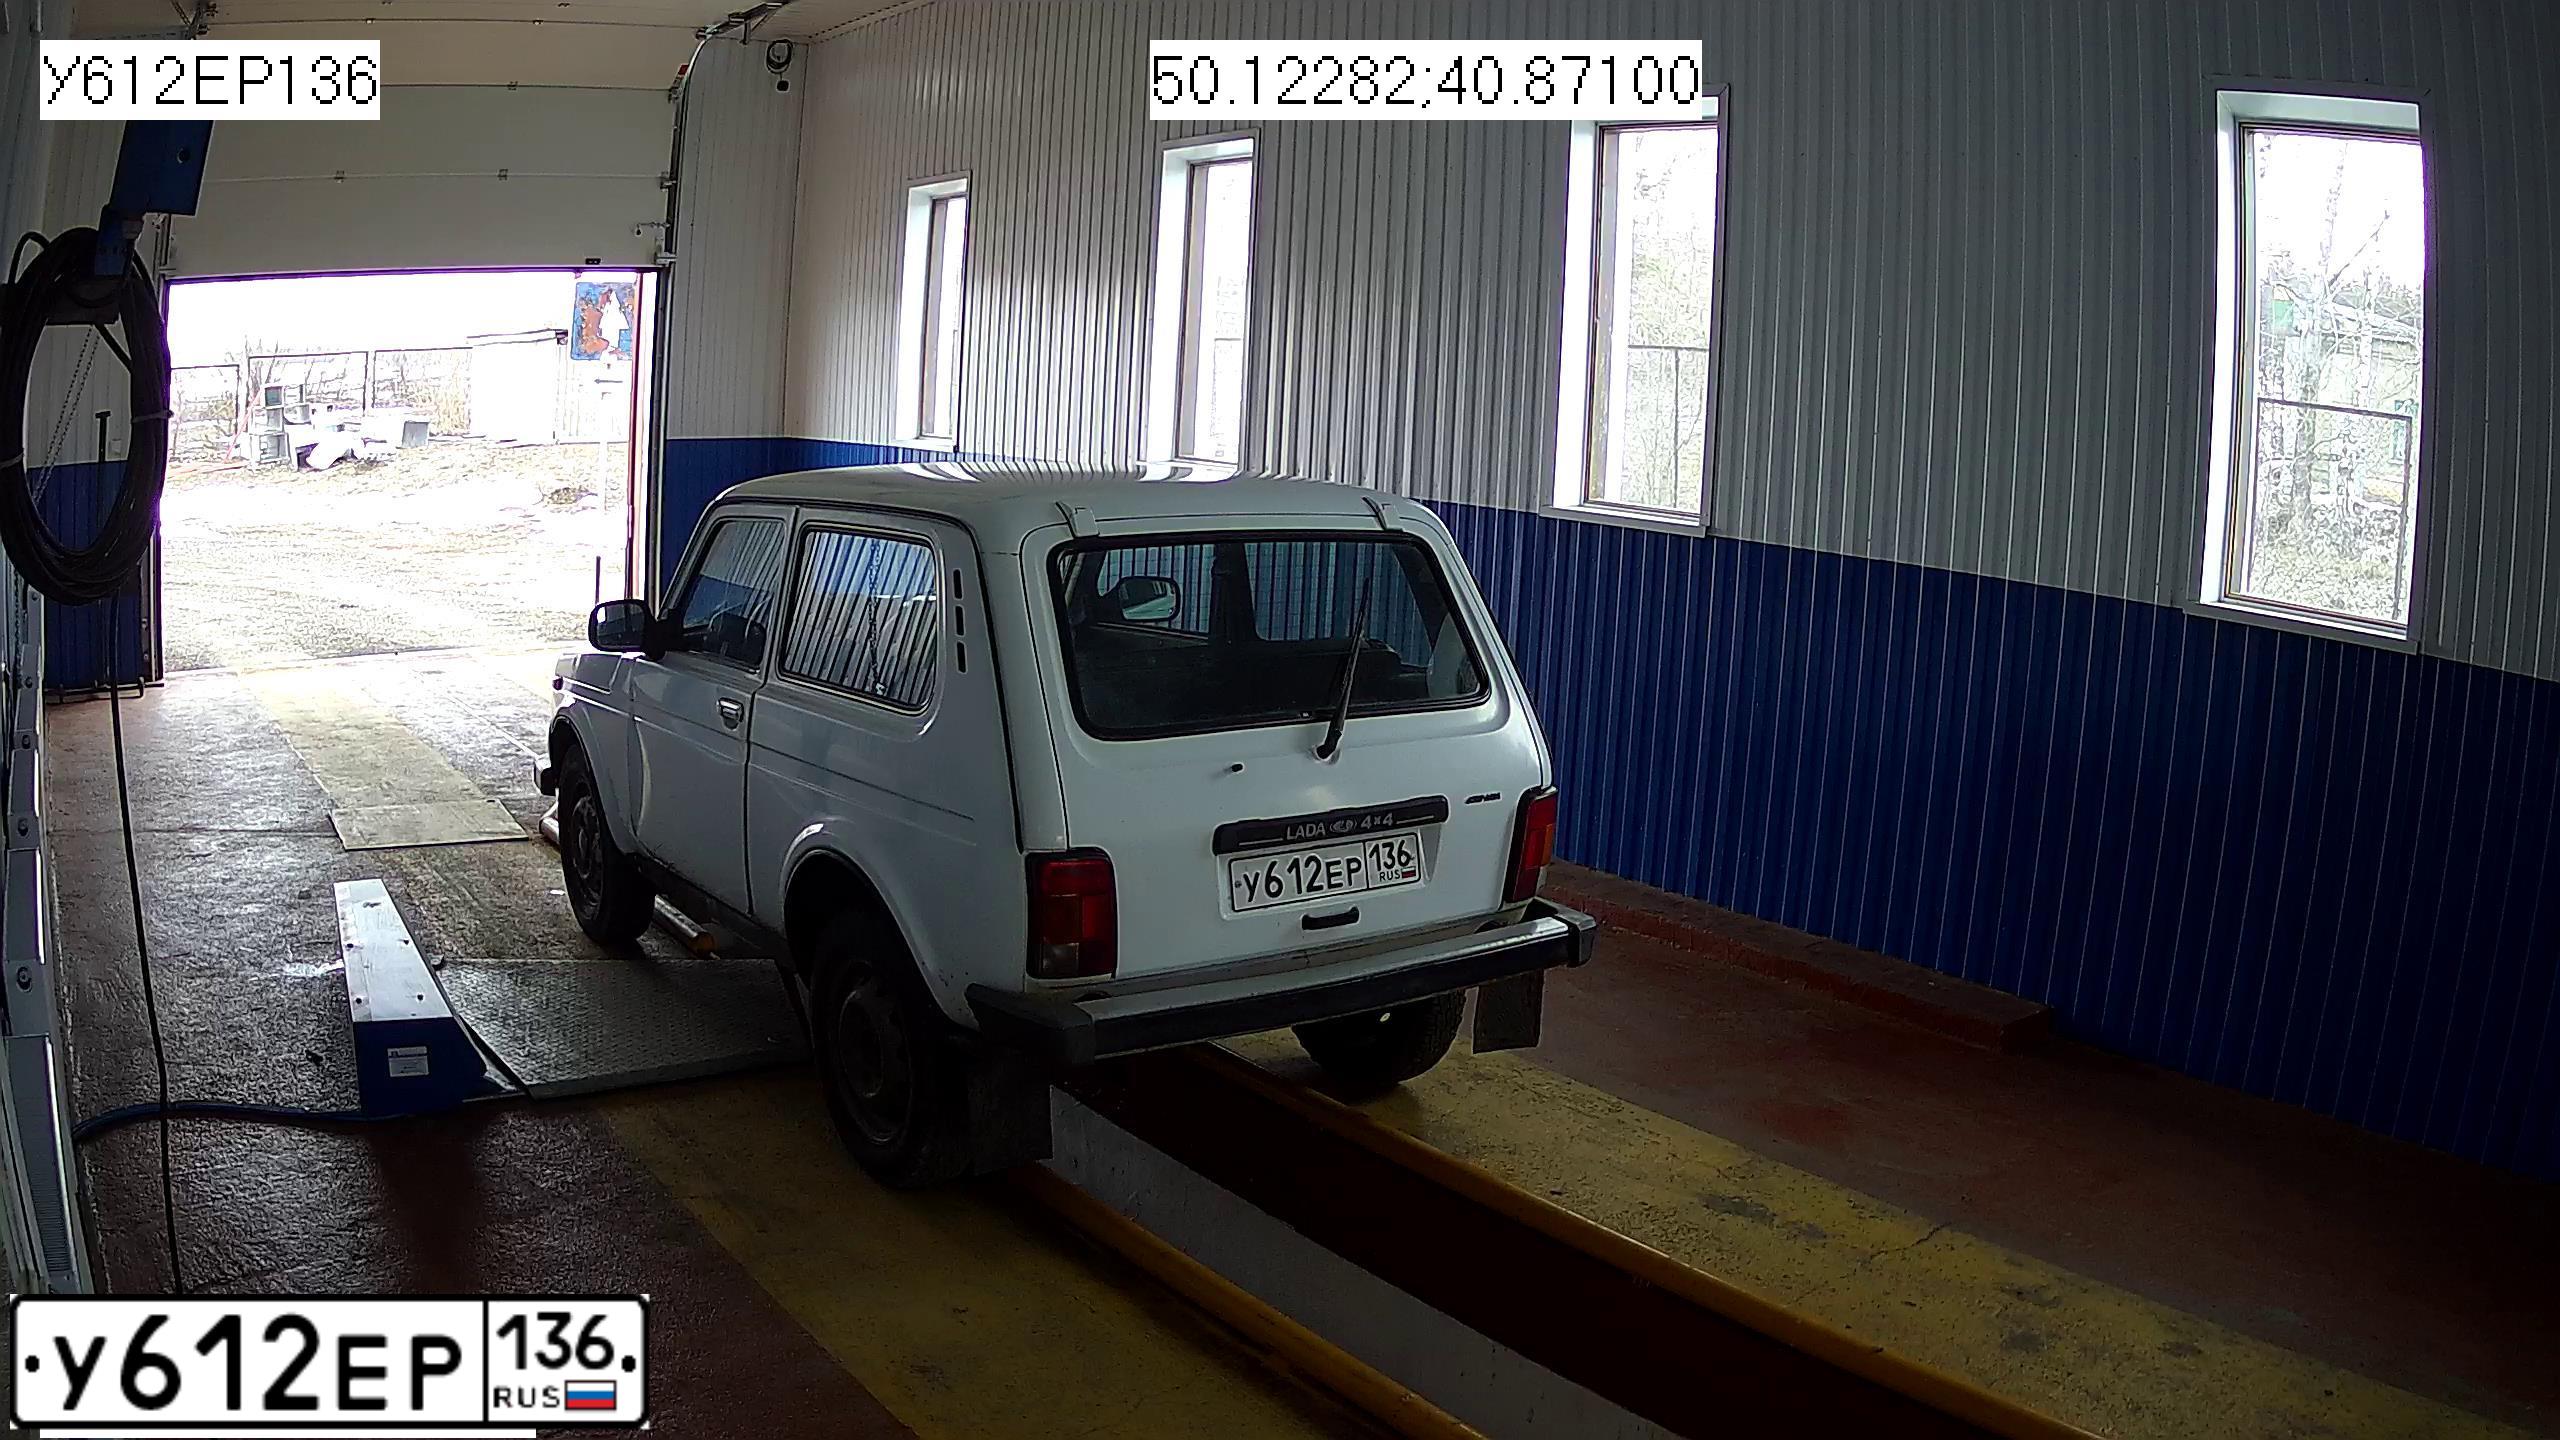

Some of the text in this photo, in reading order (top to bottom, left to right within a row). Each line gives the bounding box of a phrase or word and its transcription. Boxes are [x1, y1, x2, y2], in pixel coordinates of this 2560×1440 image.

[1286, 822, 1326, 841] LADA
[1368, 839, 1414, 872] 136
[1379, 869, 1401, 883] RUS
